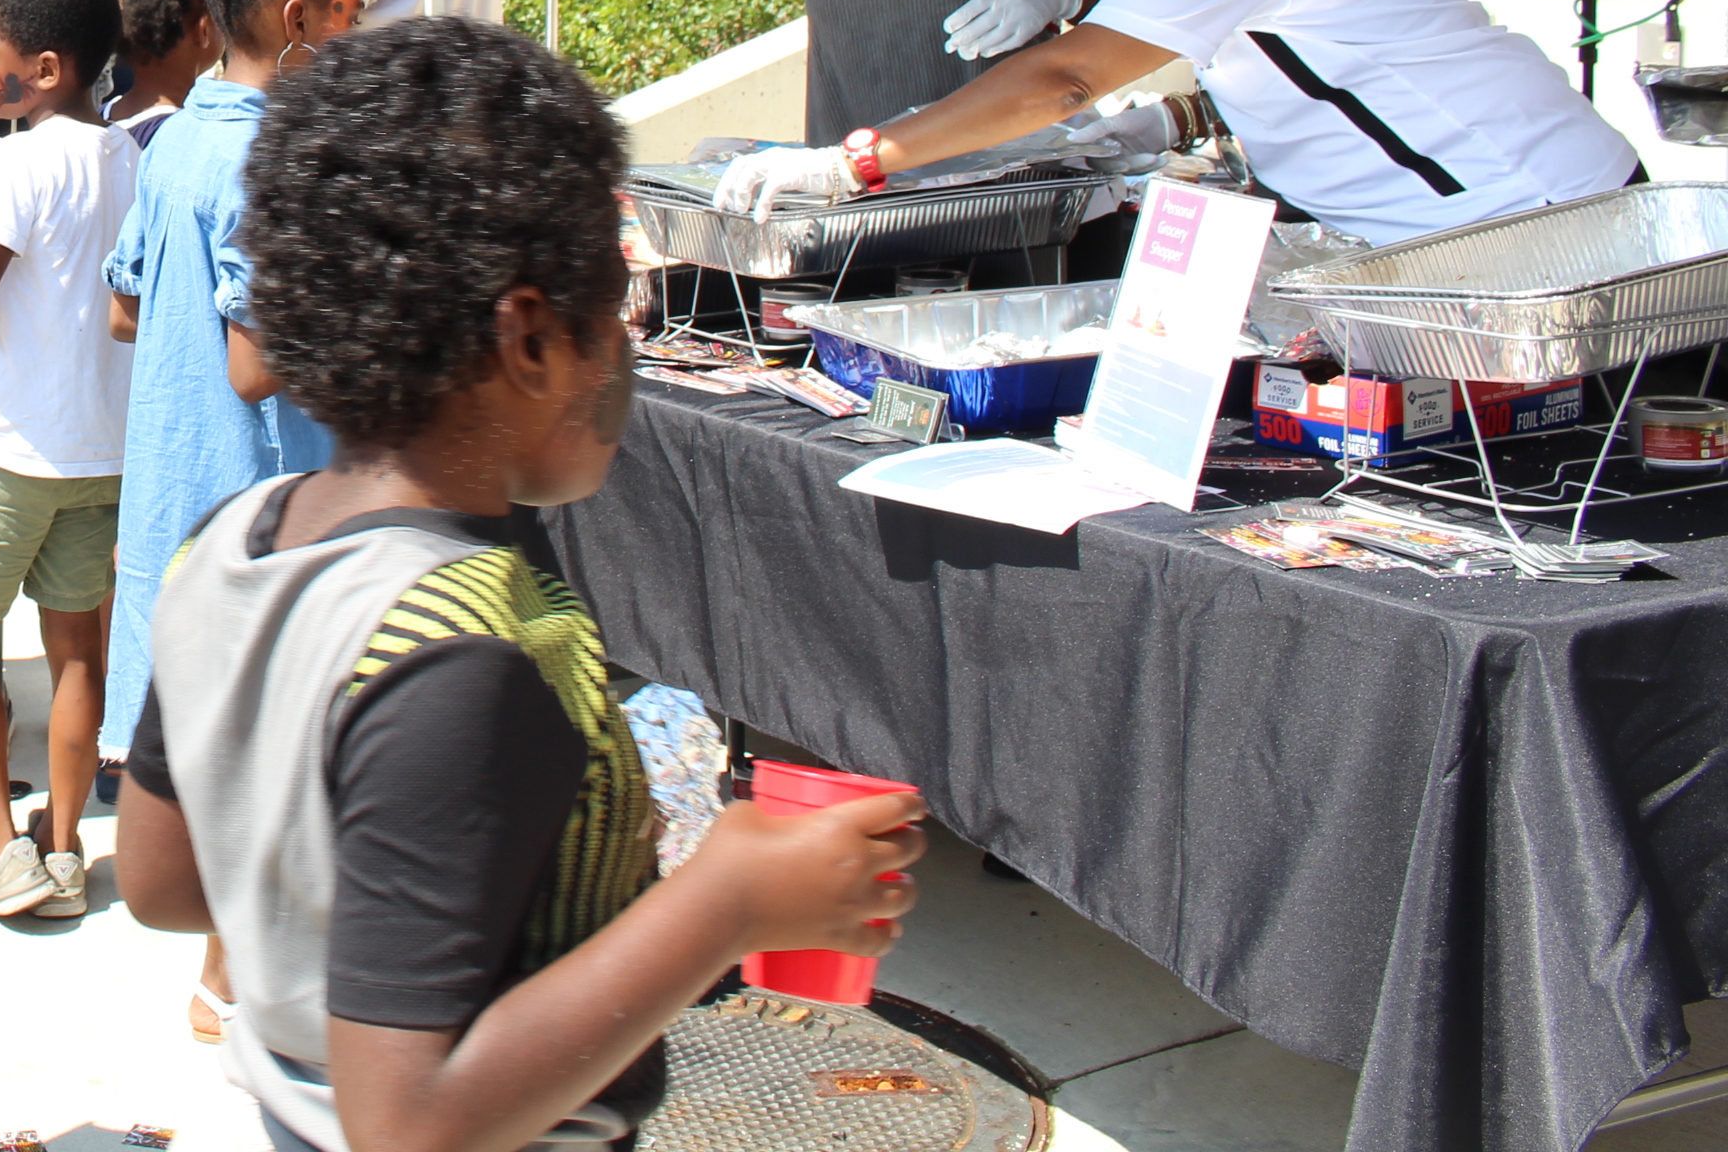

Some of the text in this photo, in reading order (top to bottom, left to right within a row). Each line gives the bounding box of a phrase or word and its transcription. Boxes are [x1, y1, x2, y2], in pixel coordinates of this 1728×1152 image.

[1161, 198, 1198, 220] Personal
[1157, 220, 1189, 244] Grocery
[1149, 240, 1184, 263] Shopper
[1273, 384, 1291, 394] FOOD
[1545, 388, 1579, 406] ALUMINUM
[1267, 394, 1297, 405] SERVICE
[1418, 400, 1437, 413] FOOD
[1413, 414, 1443, 428] SERVICE
[1516, 400, 1579, 431] FOIL SHEETS
[1259, 413, 1303, 445] 500
[1318, 436, 1341, 453] FOIL
